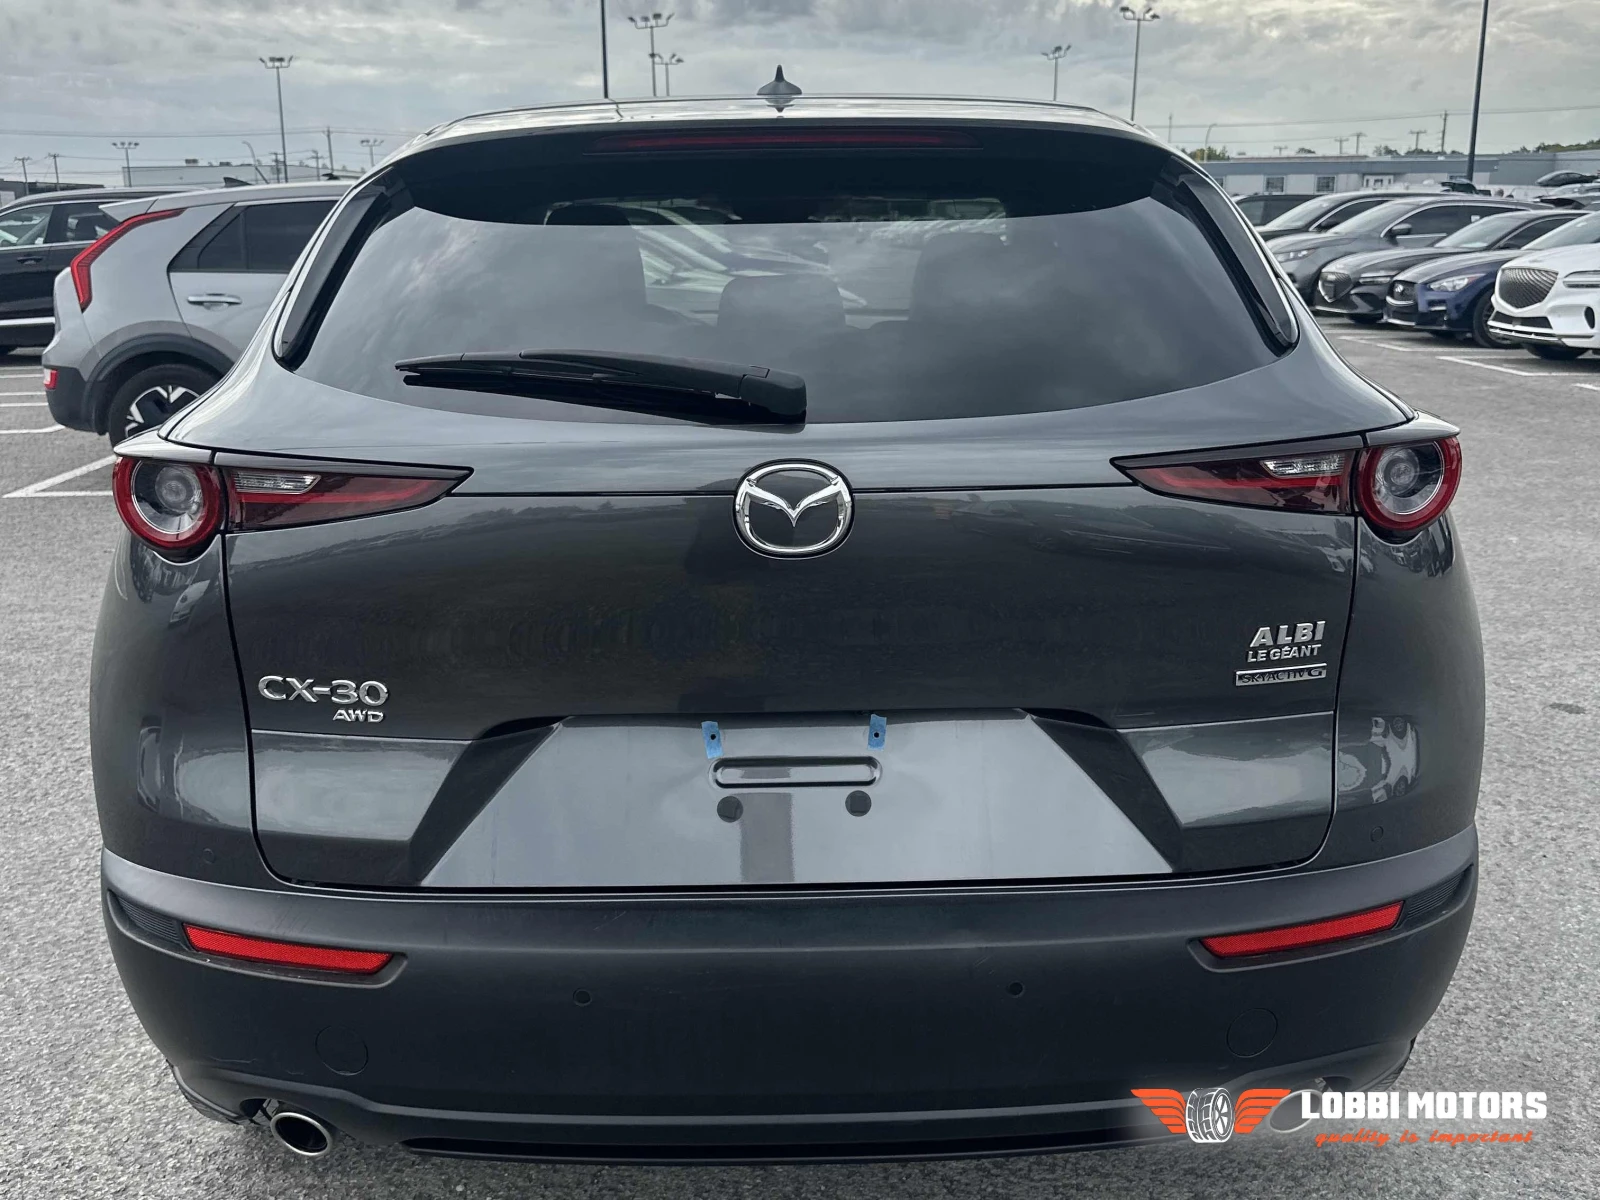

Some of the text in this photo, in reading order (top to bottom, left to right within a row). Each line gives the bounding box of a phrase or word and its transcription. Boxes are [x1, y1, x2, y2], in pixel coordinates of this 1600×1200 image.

[1249, 620, 1326, 647] ALBI
[1247, 650, 1268, 662] LE
[258, 675, 389, 706] CX-30
[332, 708, 384, 723] AWD
